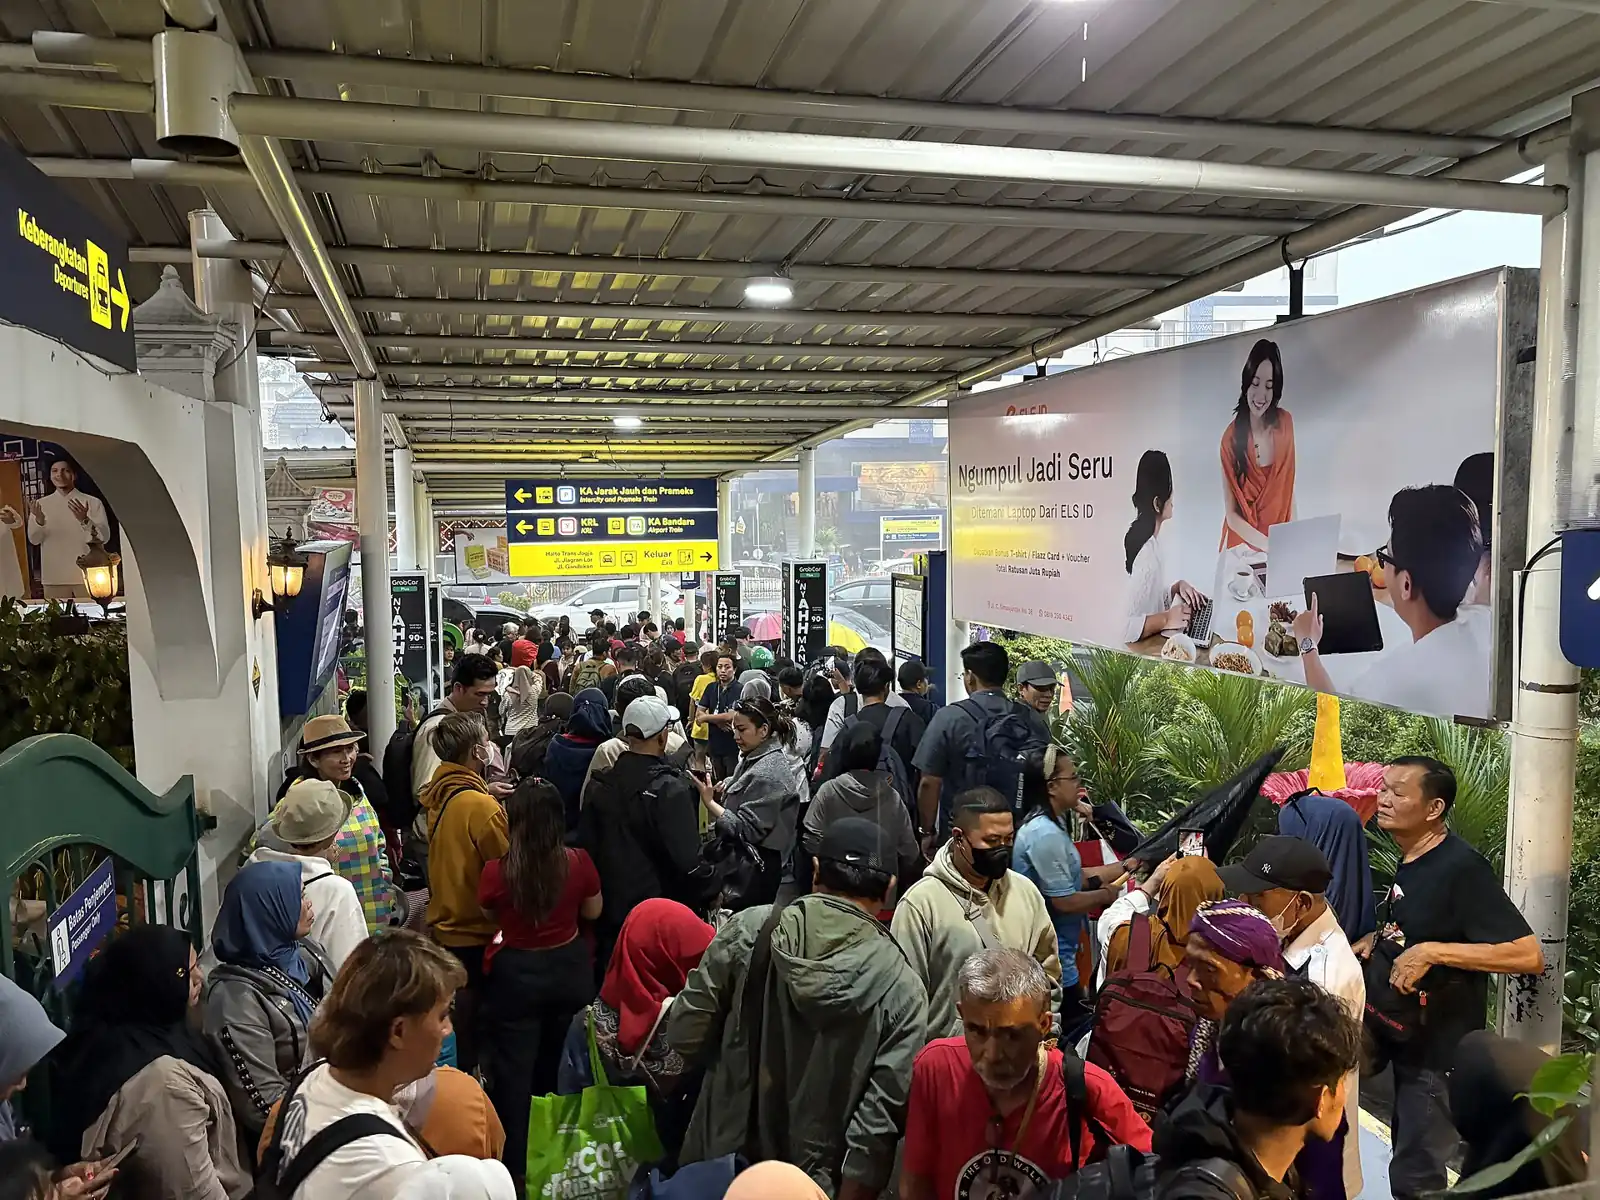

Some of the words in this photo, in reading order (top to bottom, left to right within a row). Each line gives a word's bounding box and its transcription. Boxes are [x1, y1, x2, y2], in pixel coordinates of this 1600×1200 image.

[18, 208, 87, 275] Keberangkatan
[54, 264, 89, 300] Departures
[958, 456, 1023, 493] Ngumpul
[1026, 452, 1061, 483] Jadi
[1068, 452, 1113, 481] Seru
[579, 486, 593, 496] KA
[594, 486, 619, 496] Jarak
[620, 486, 640, 495] Jauh
[641, 486, 658, 495] dan
[659, 486, 694, 495] Prameks
[579, 496, 604, 504] Intercity
[647, 517, 661, 526] KA
[662, 516, 695, 526] Bandara
[971, 506, 1004, 519] Ditemani
[1007, 505, 1036, 522] Laptop
[1039, 503, 1058, 519] Dari
[1061, 504, 1079, 519] ELS
[1083, 504, 1094, 519] ID
[580, 517, 599, 527] KRL
[647, 526, 668, 534] Airport
[1010, 549, 1027, 559] T-shirt
[1032, 550, 1046, 560] Flazz
[1046, 551, 1060, 561] Card
[1066, 553, 1090, 563] Voucher
[996, 564, 1007, 573] Total
[1008, 565, 1028, 574] Ratusan
[1029, 566, 1040, 576] Juta
[1041, 568, 1060, 579] Rupiah
[67, 904, 84, 932] Batas
[83, 872, 112, 914] Penjemput
[71, 921, 92, 954] Passenger
[91, 911, 101, 929] Only
[963, 1162, 980, 1180] THE
[983, 1155, 1007, 1165] OD
